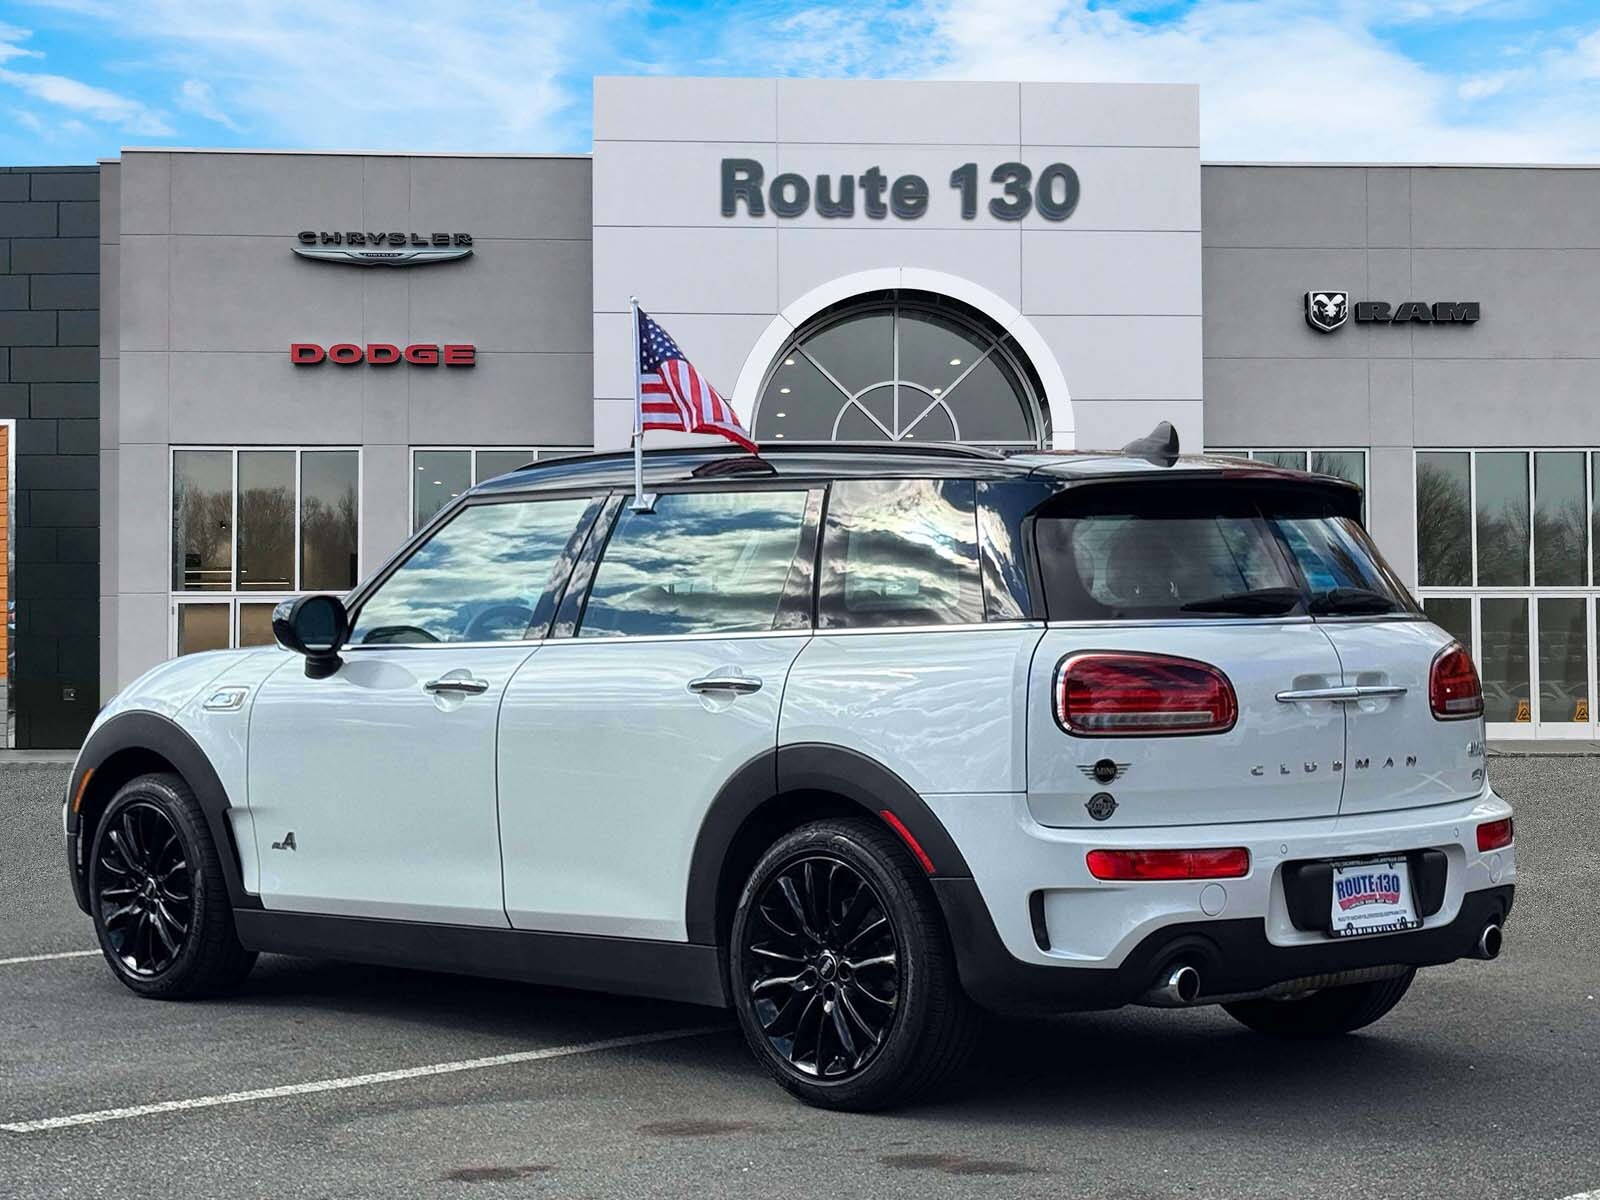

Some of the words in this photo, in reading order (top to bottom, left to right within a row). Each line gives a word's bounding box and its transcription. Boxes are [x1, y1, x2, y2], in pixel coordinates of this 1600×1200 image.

[721, 158, 929, 219] Route
[950, 162, 1080, 222] 130
[298, 231, 472, 245] CHRYSLER
[1355, 302, 1480, 324] RAM
[291, 343, 476, 366] DODGE
[1251, 756, 1417, 776] CLUBMAN
[1336, 875, 1375, 900] ROUTE
[1376, 874, 1400, 893] 130
